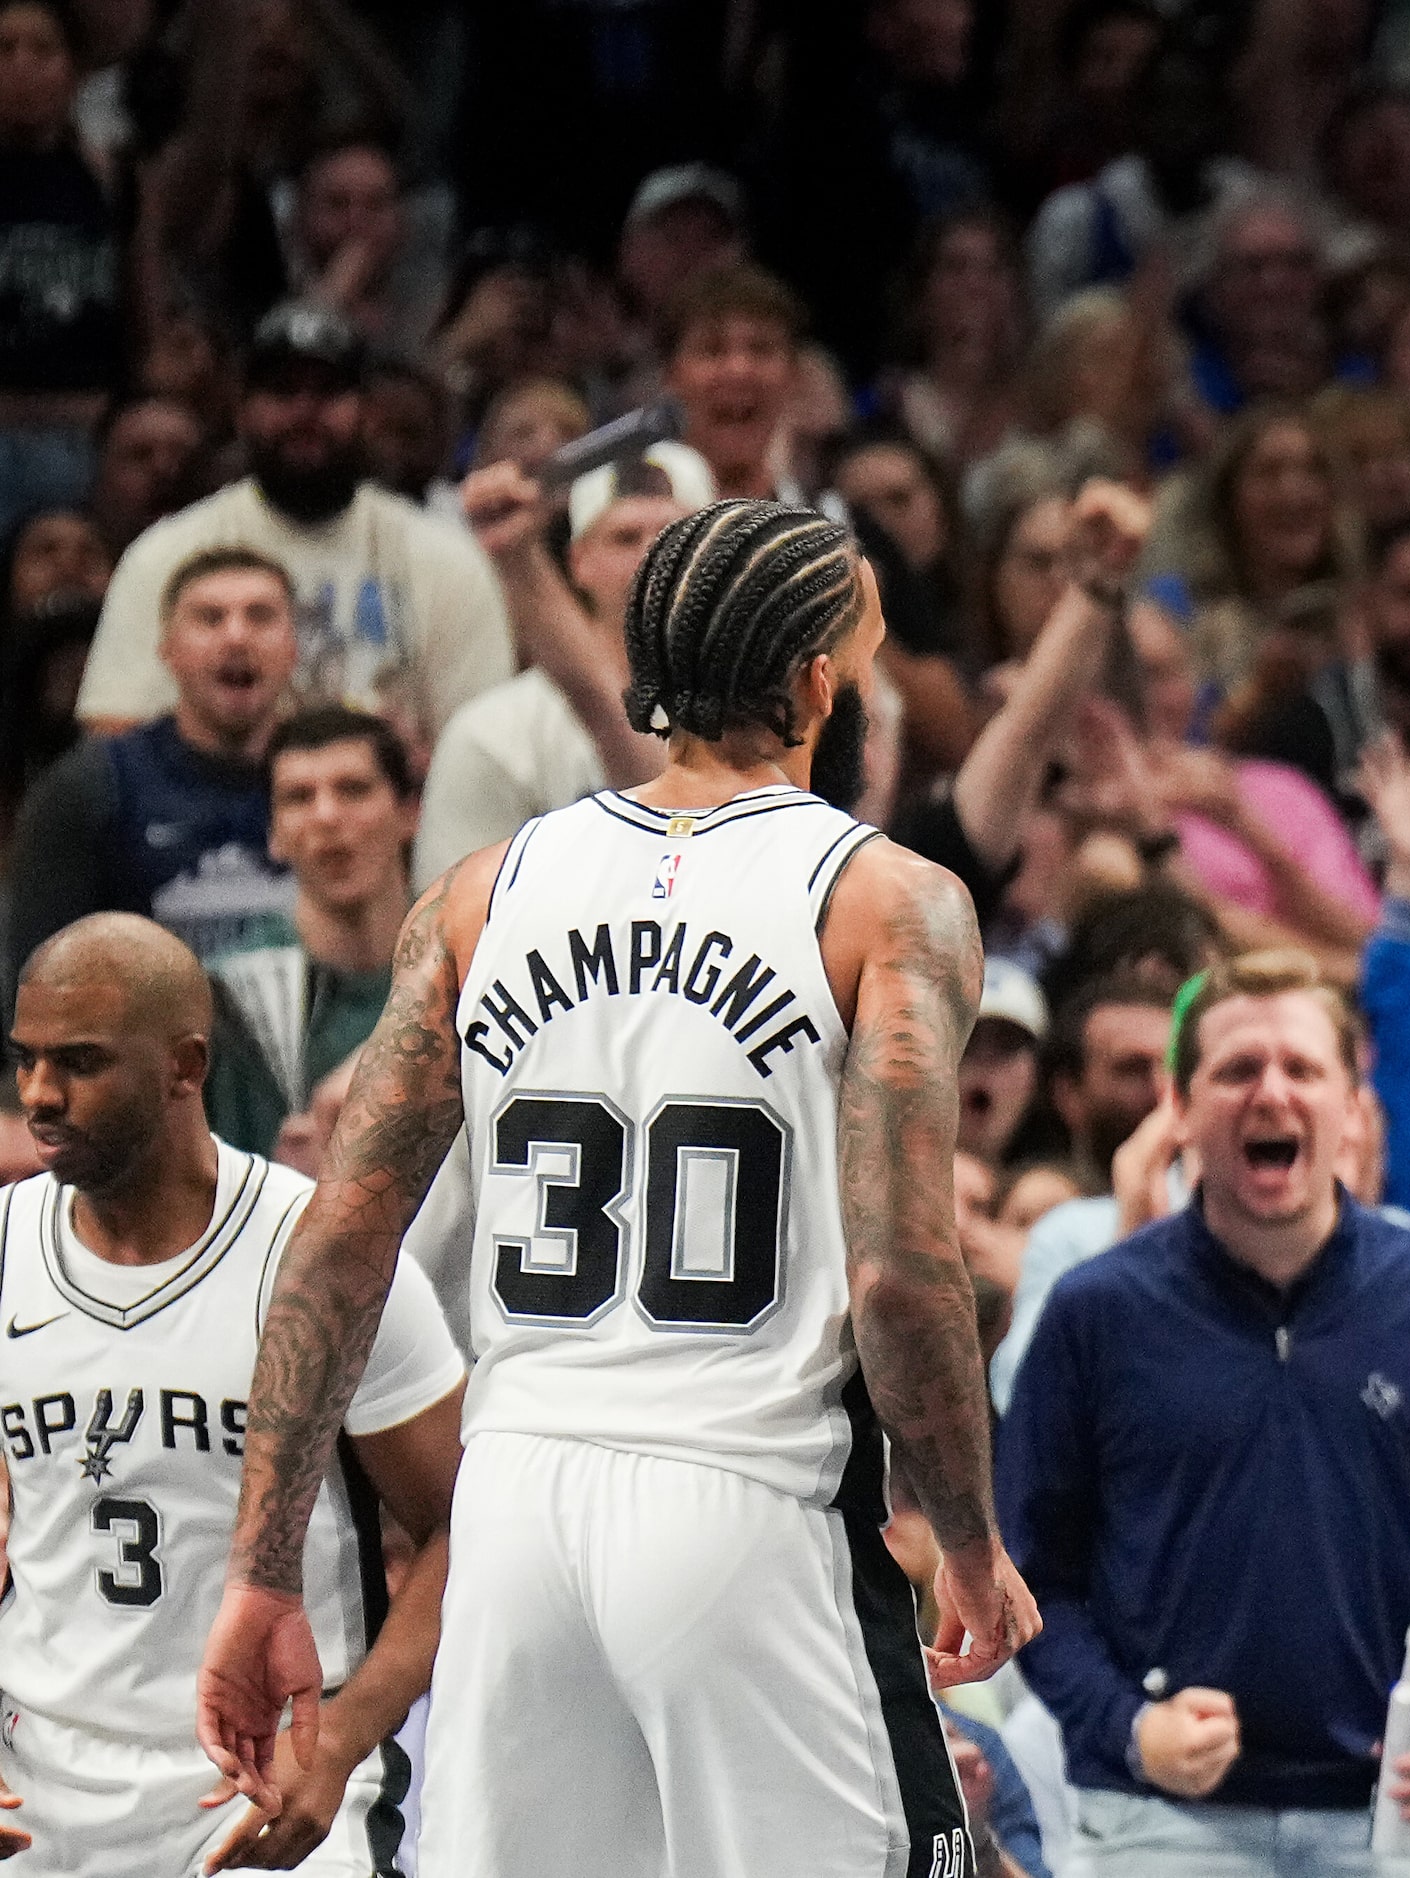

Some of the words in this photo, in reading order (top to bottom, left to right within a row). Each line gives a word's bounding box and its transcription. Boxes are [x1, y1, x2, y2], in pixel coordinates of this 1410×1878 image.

[464, 920, 821, 1079] CHAMPAGNIE
[489, 1089, 793, 1336] 30
[0, 1386, 247, 1487] SPURS
[91, 1495, 168, 1611] 3
